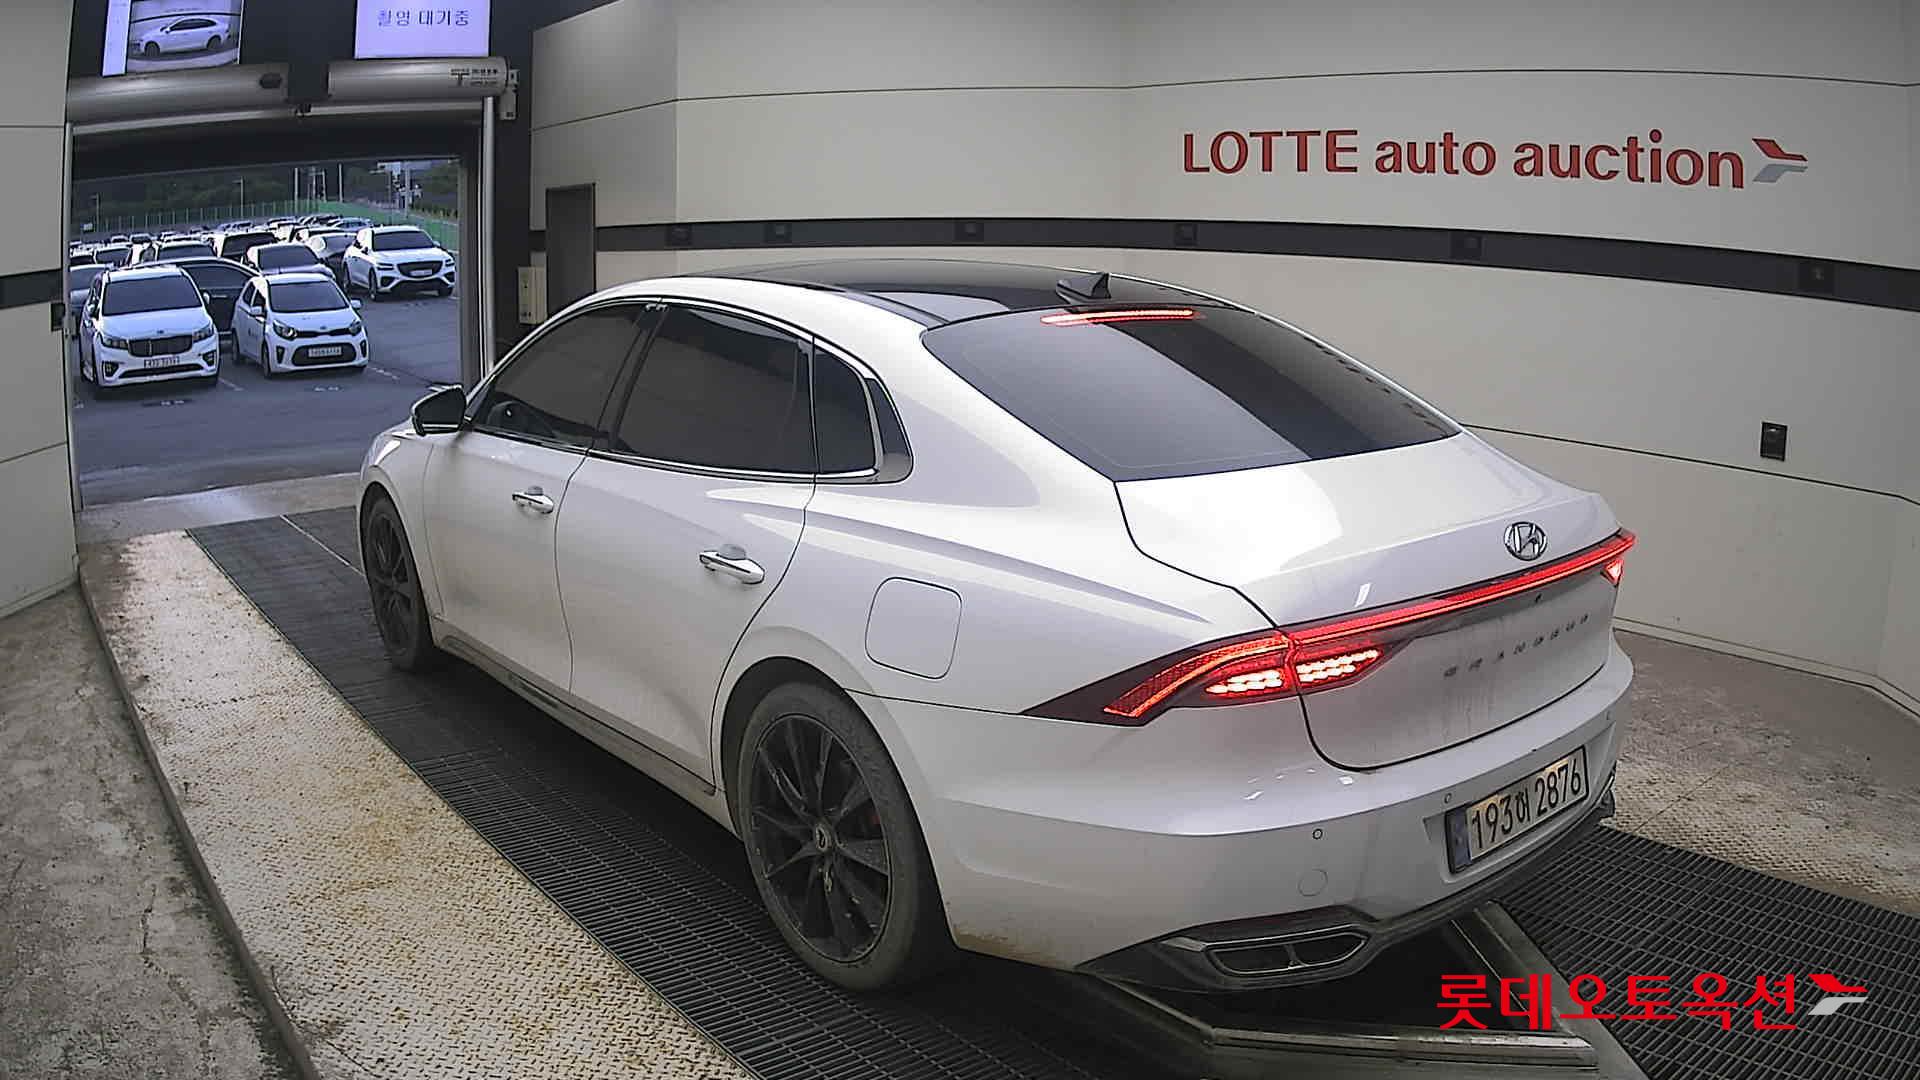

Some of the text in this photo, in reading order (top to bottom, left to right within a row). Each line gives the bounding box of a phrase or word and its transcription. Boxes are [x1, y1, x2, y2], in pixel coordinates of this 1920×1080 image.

[418, 9, 469, 27] 대기중
[1184, 128, 1745, 189] LOTTE auto auction
[1471, 758, 1581, 849] 193허 2876
